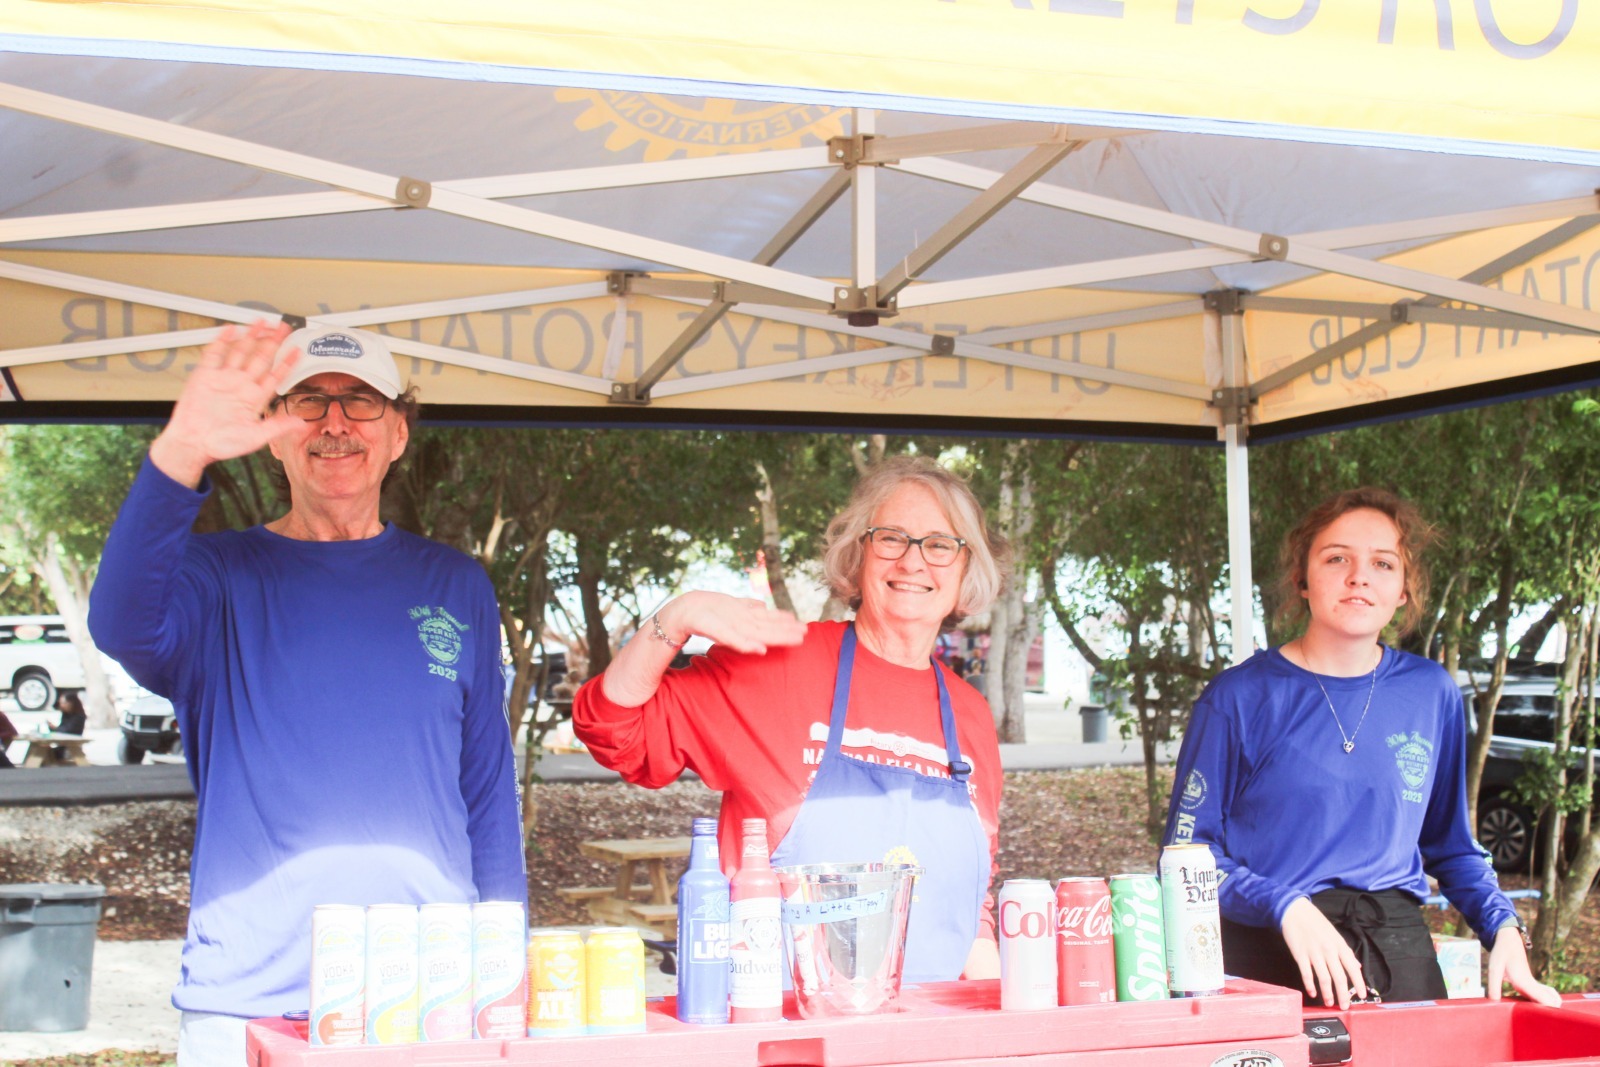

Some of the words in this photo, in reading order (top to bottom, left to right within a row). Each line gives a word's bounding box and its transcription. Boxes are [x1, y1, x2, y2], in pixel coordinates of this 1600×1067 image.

[417, 624, 443, 637] UPPER
[443, 630, 462, 641] KEYS
[428, 663, 458, 682] 2025
[1402, 789, 1423, 804] 2025
[820, 902, 852, 914] Little
[1124, 876, 1170, 1001] Sprite
[322, 963, 354, 978] VODKA
[379, 962, 411, 977] VODKA
[427, 959, 459, 975] VODKA
[478, 958, 509, 974] VODKA
